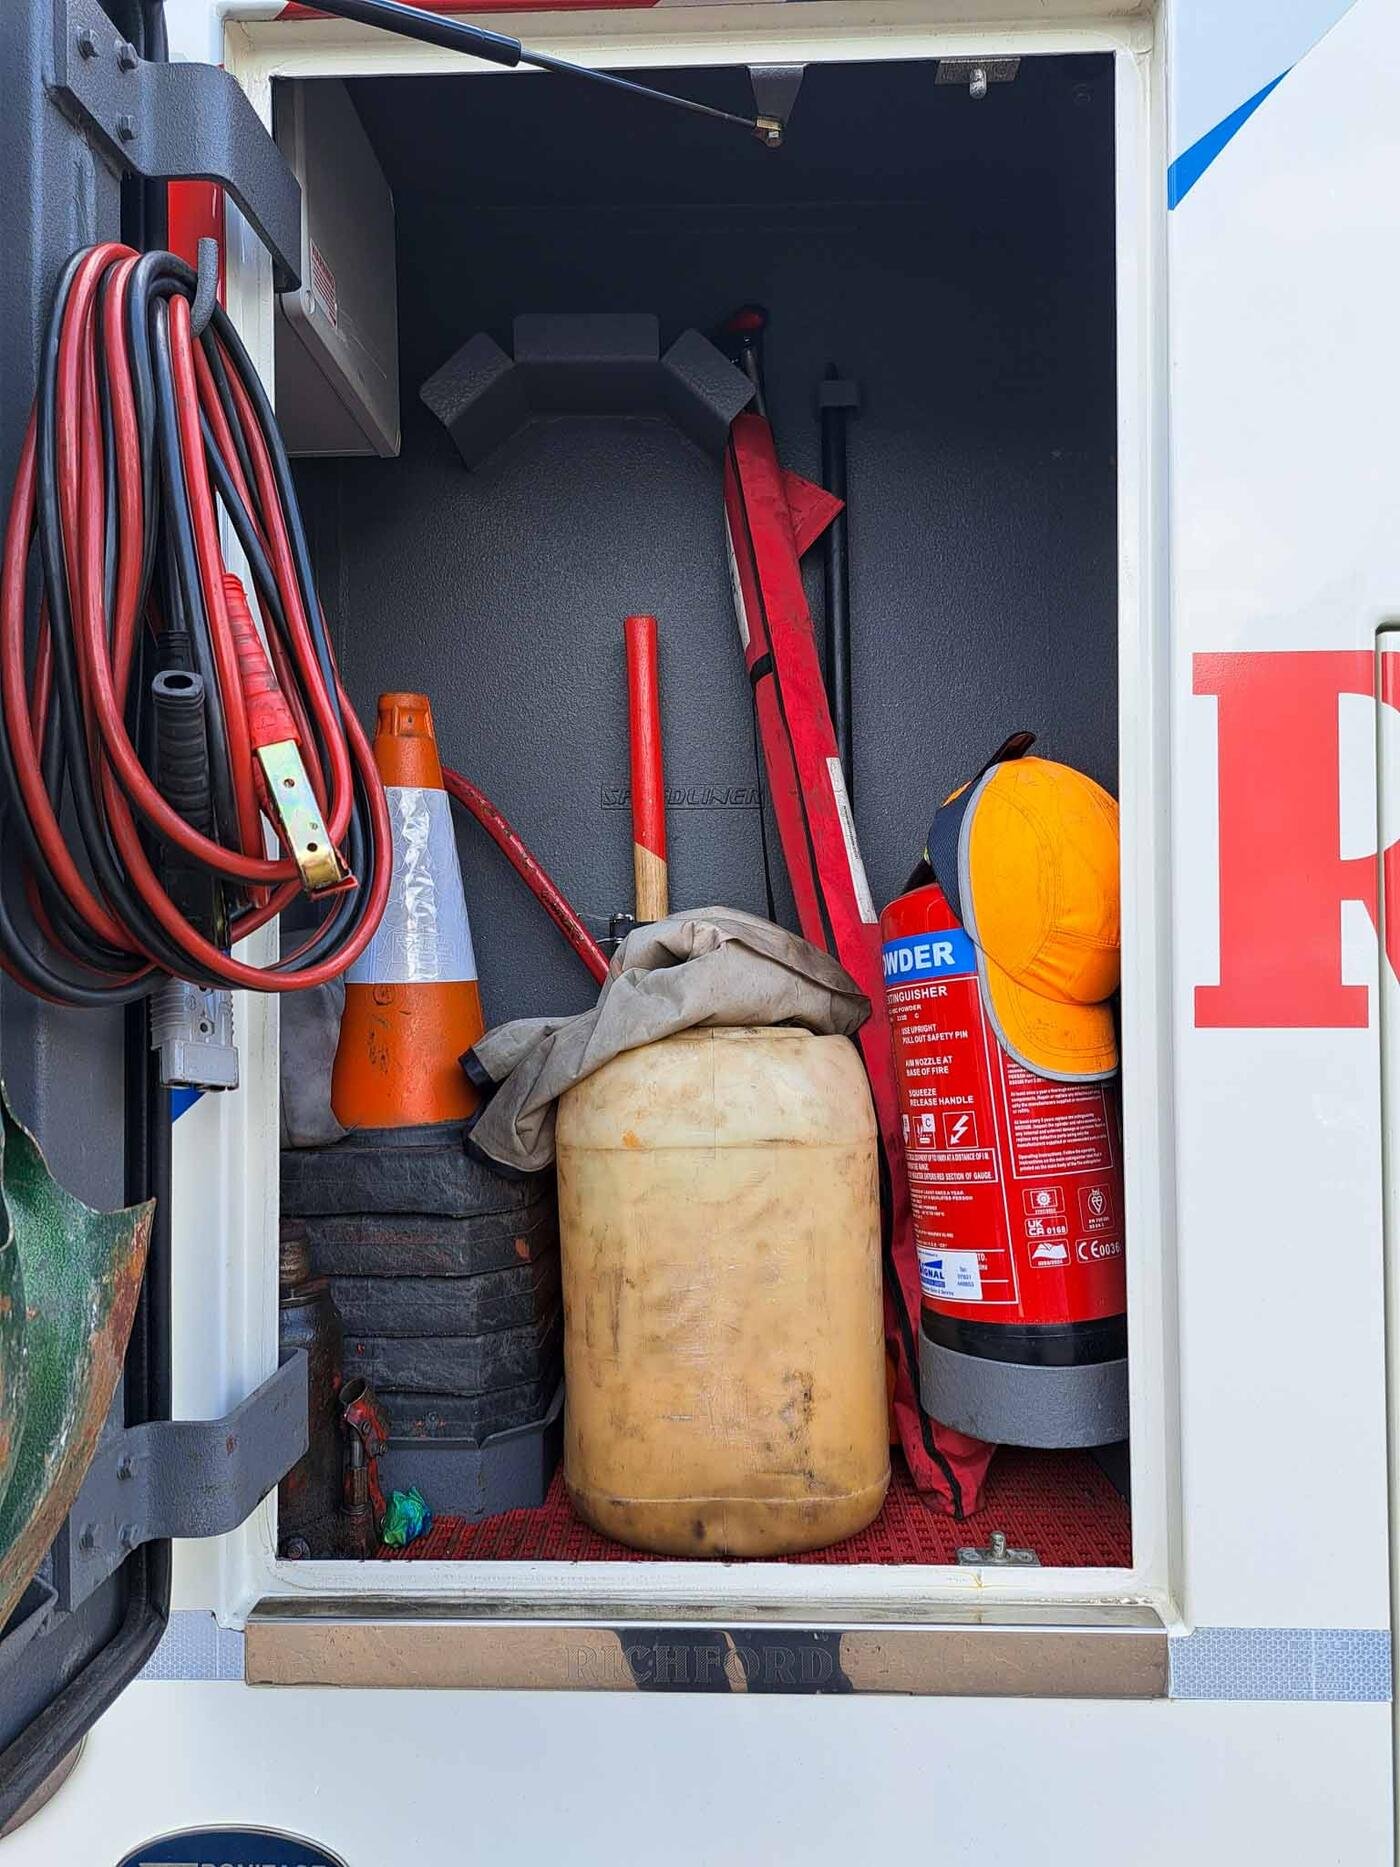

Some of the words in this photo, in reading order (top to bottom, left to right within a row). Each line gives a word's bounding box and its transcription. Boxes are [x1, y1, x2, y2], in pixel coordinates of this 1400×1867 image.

[602, 787, 761, 806] SPDLINER
[1193, 651, 1400, 1028] R
[882, 941, 956, 977] WDER
[901, 1026, 911, 1035] USE
[911, 1024, 937, 1034] UPRIGHT
[902, 1035, 915, 1044] PULL
[915, 1034, 926, 1043] OUT
[927, 1031, 954, 1042] SAFETY
[955, 1030, 968, 1038] PIN
[905, 1059, 914, 1067] AIM
[915, 1056, 942, 1066] NOZZLE
[942, 1055, 953, 1064] AT
[906, 1068, 921, 1077] BASE
[921, 1067, 931, 1076] OF
[931, 1066, 949, 1075] FIRE
[908, 1088, 937, 1098] SQUEEZE
[909, 1098, 938, 1107] RELEASE
[938, 1095, 974, 1105] HANDLE
[1028, 1219, 1043, 1228] UK
[1029, 1227, 1045, 1236] CA
[566, 1645, 834, 1684] RICHFORD
